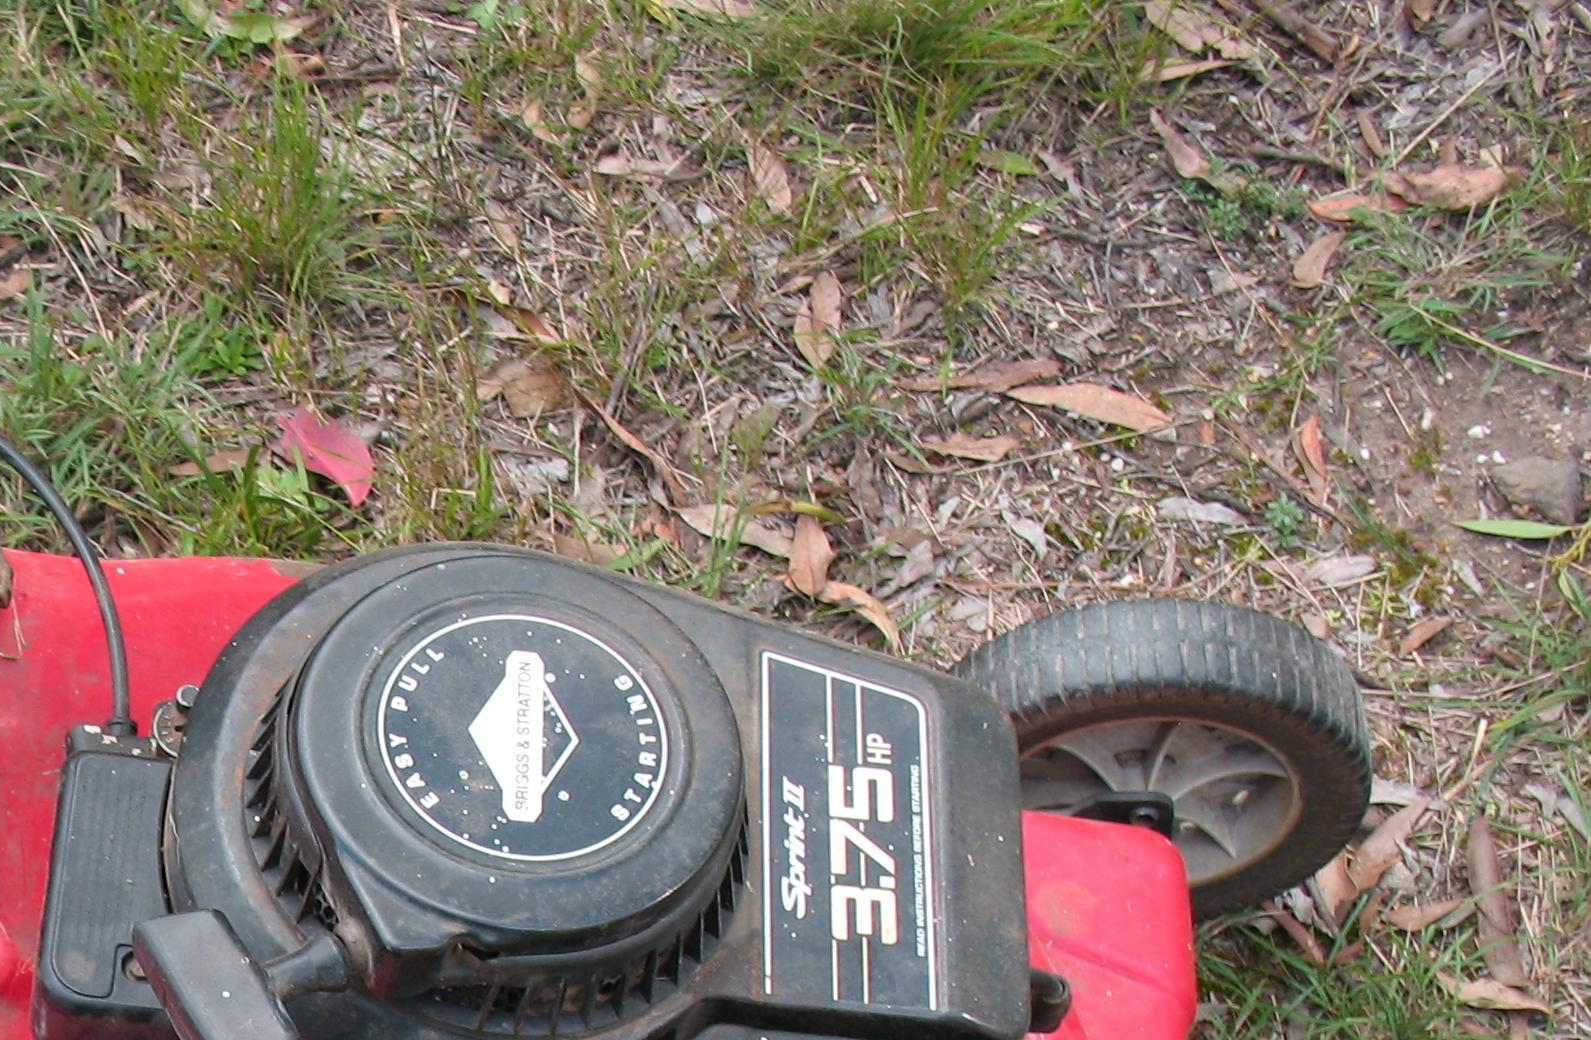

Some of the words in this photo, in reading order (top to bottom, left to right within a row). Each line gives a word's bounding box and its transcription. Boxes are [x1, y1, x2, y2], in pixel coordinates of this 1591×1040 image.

[390, 647, 444, 712] PULL
[517, 661, 532, 735] STRATTON
[388, 732, 440, 808] EASY
[515, 736, 530, 752] &
[610, 674, 659, 821] STARTING
[514, 755, 529, 811] BRIGGS
[782, 775, 805, 812] II
[910, 764, 921, 813] STARTING
[781, 808, 812, 920] Sprint
[828, 764, 898, 946] 3.75
[866, 733, 892, 765] HP
[912, 815, 923, 853] BEFORE
[913, 855, 925, 927] INSTRUCTIONS
[916, 929, 926, 957] READ
